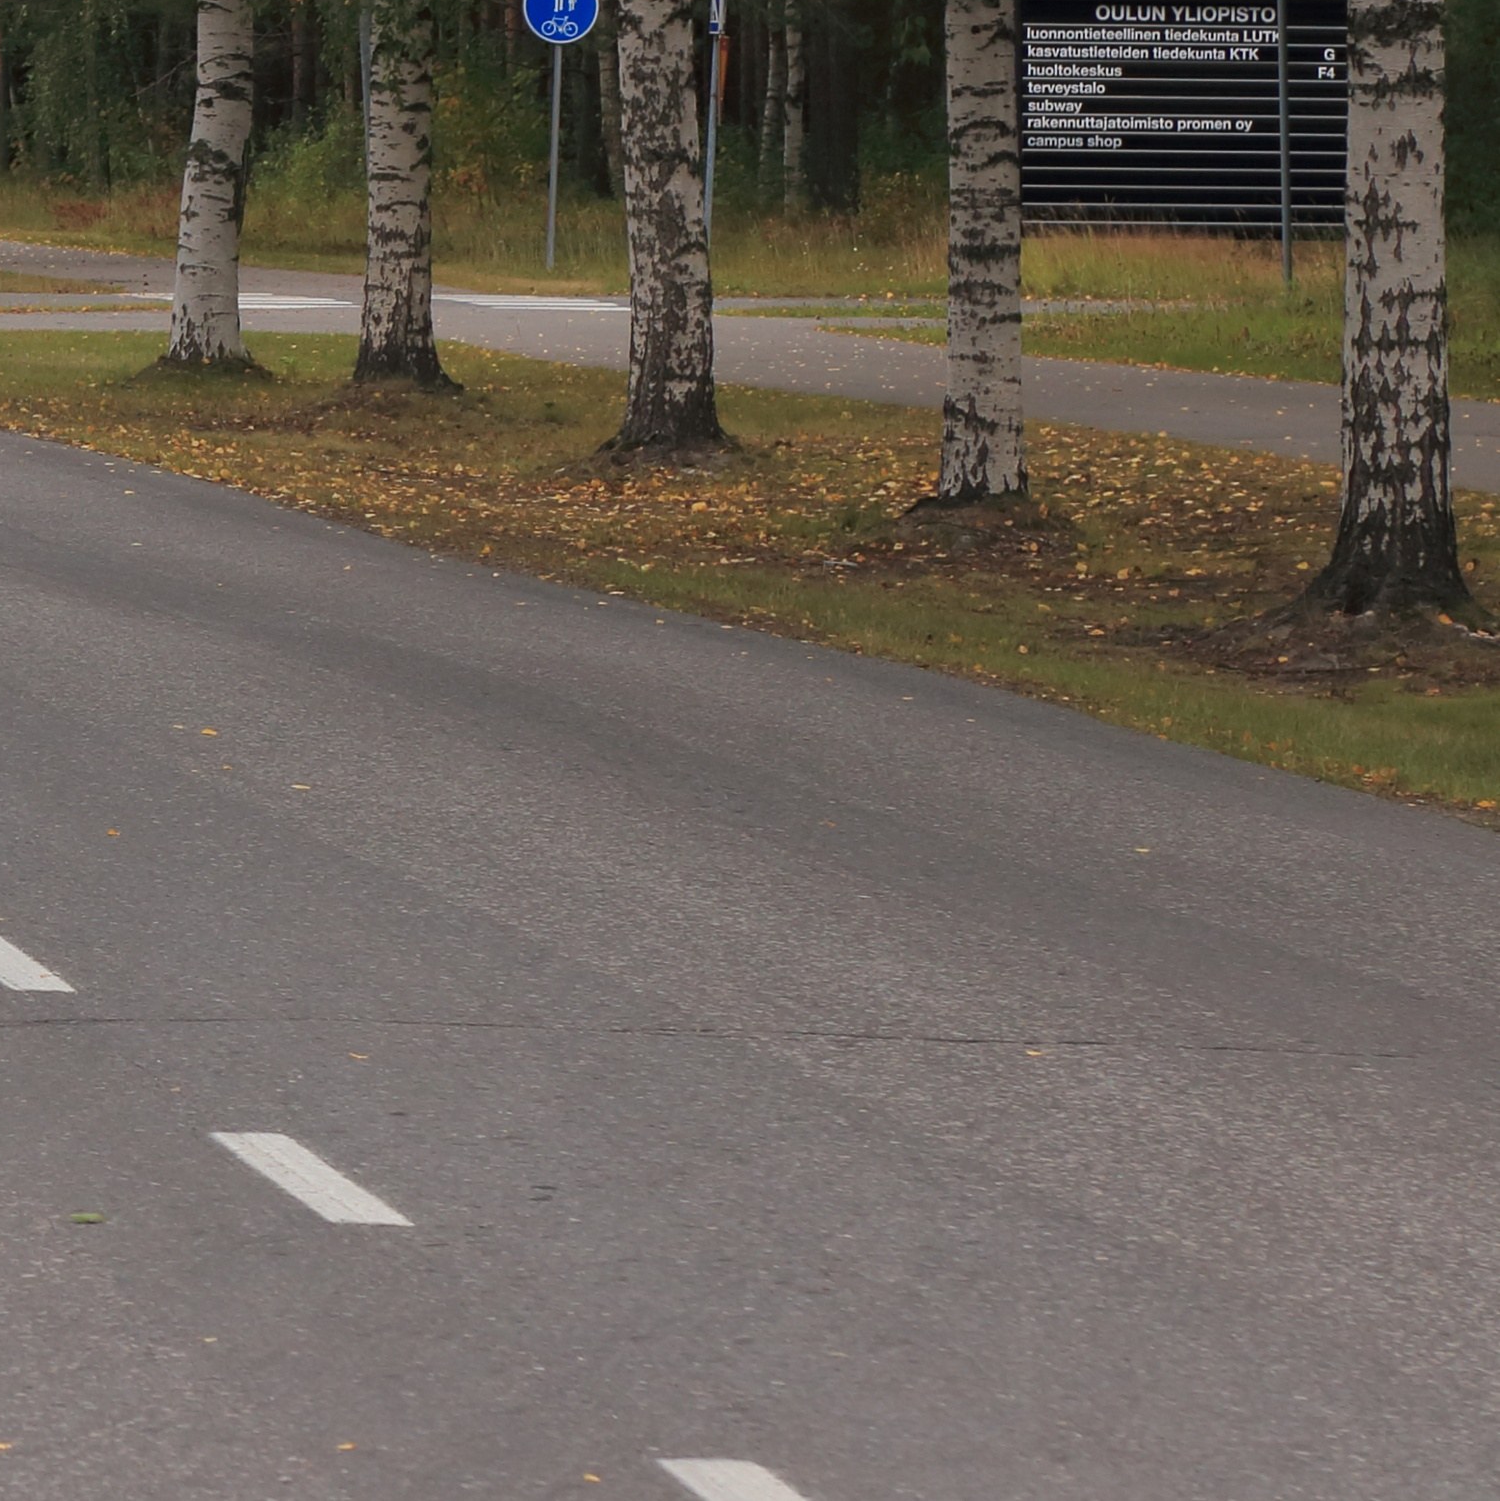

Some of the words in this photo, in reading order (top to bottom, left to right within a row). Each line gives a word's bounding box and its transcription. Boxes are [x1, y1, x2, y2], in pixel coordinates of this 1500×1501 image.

[1095, 4, 1166, 22] OULUN
[1171, 6, 1276, 23] YLIOPISTO
[1026, 27, 1161, 41] luonnontieteellinen
[1164, 28, 1240, 42] tiedekunta
[1027, 45, 1149, 59] kasvatustieteiden
[1152, 46, 1226, 60] tiedekunta
[1229, 48, 1260, 61] KTK
[1324, 48, 1336, 61] G
[1027, 63, 1123, 77] huoltokeskus
[1318, 66, 1336, 79] F4
[1027, 81, 1106, 96] terveystalo
[1028, 99, 1083, 114] subway
[1027, 116, 1174, 131] rakennuttajatoimisto
[1177, 119, 1232, 132] promen
[1235, 119, 1253, 133] oy
[1027, 135, 1084, 149] campus
[1087, 134, 1123, 149] shop
